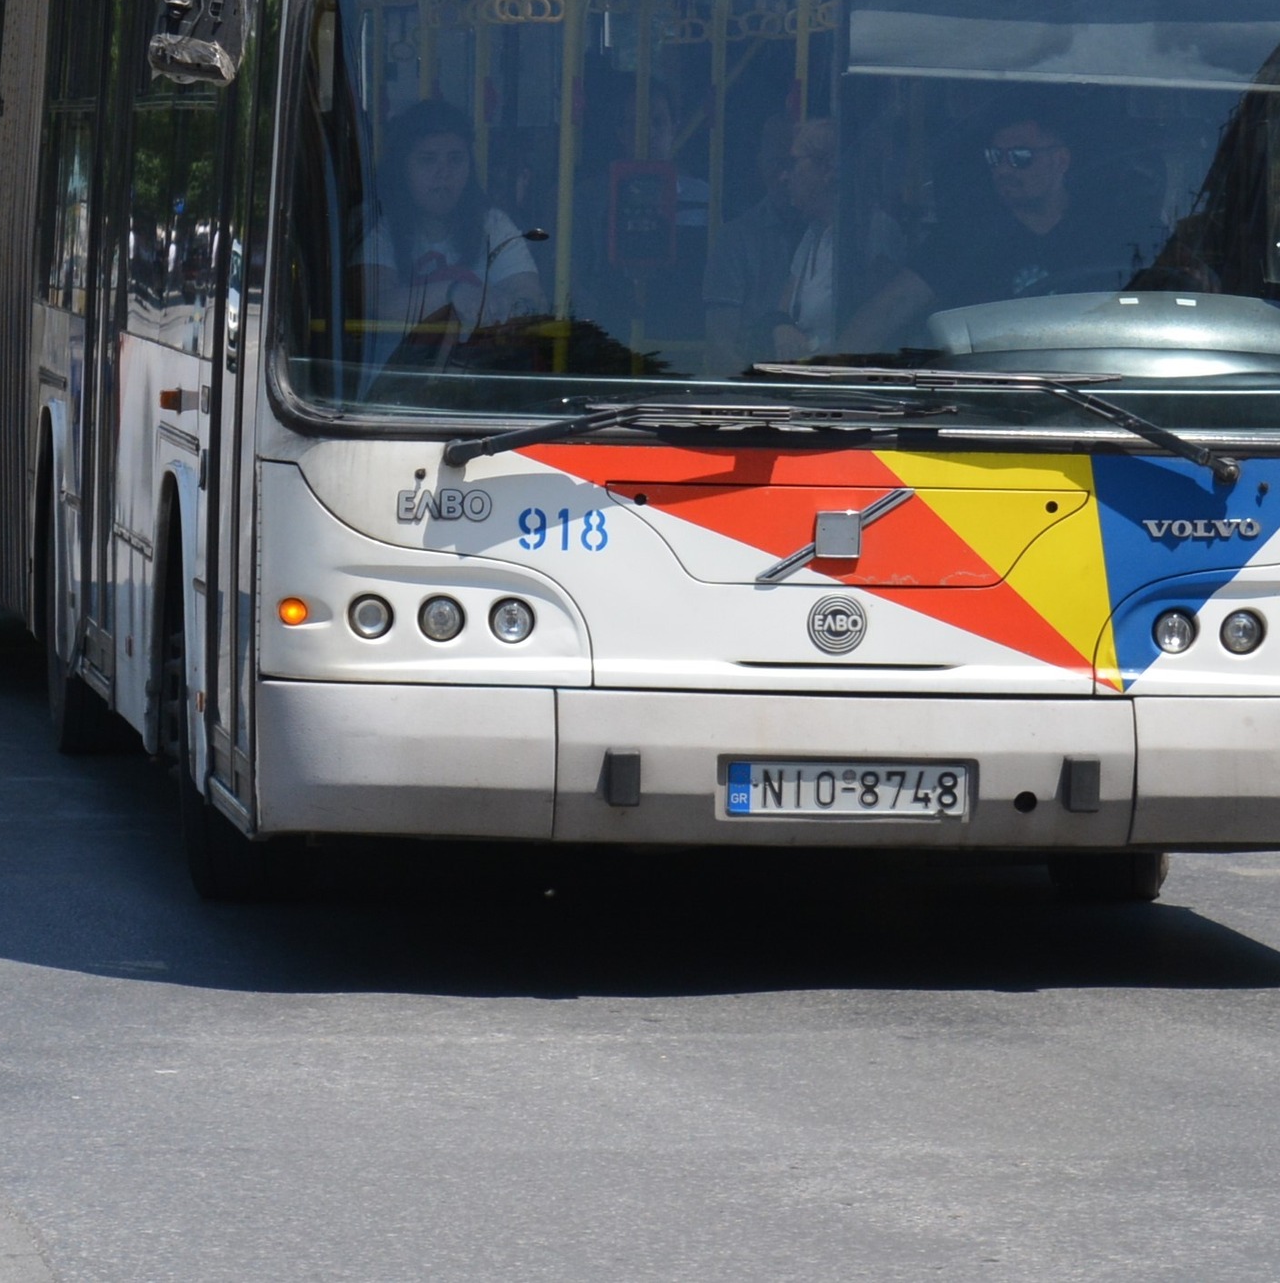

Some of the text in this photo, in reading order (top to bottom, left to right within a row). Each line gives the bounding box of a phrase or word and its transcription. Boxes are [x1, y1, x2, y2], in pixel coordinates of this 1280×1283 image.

[397, 488, 493, 523] ΕΛΒΟ
[518, 507, 609, 552] 918
[1142, 518, 1260, 538] VOLVO
[813, 614, 862, 632] ΕΛΒΟ
[730, 792, 748, 804] GR
